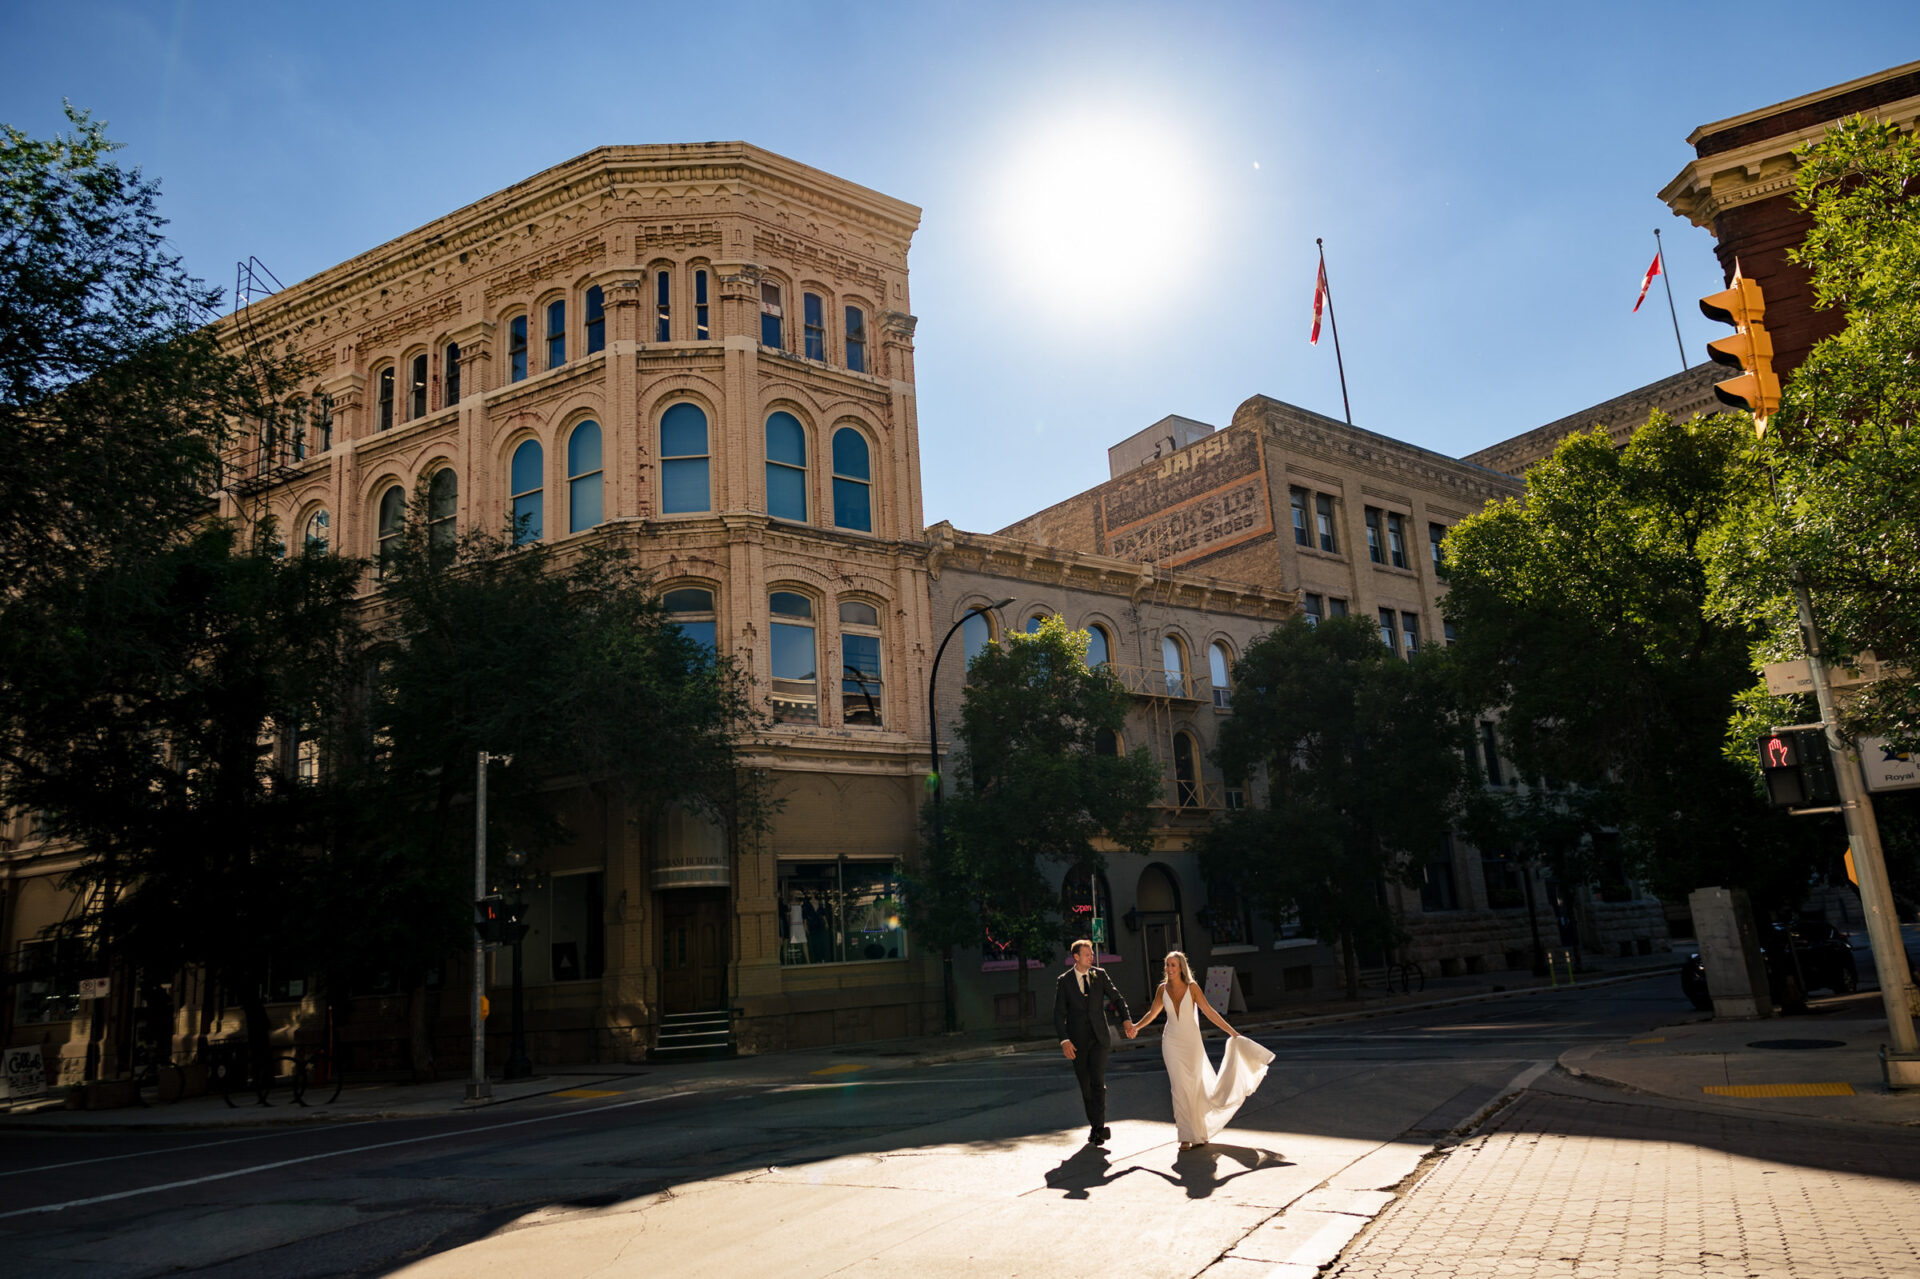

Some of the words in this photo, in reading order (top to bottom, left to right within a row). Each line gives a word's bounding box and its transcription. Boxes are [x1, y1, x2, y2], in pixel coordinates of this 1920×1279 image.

[1156, 432, 1229, 480] JAPS!
[1203, 511, 1254, 544] SHOES
[1885, 772, 1915, 782] Royal
[1072, 904, 1093, 915] Open
